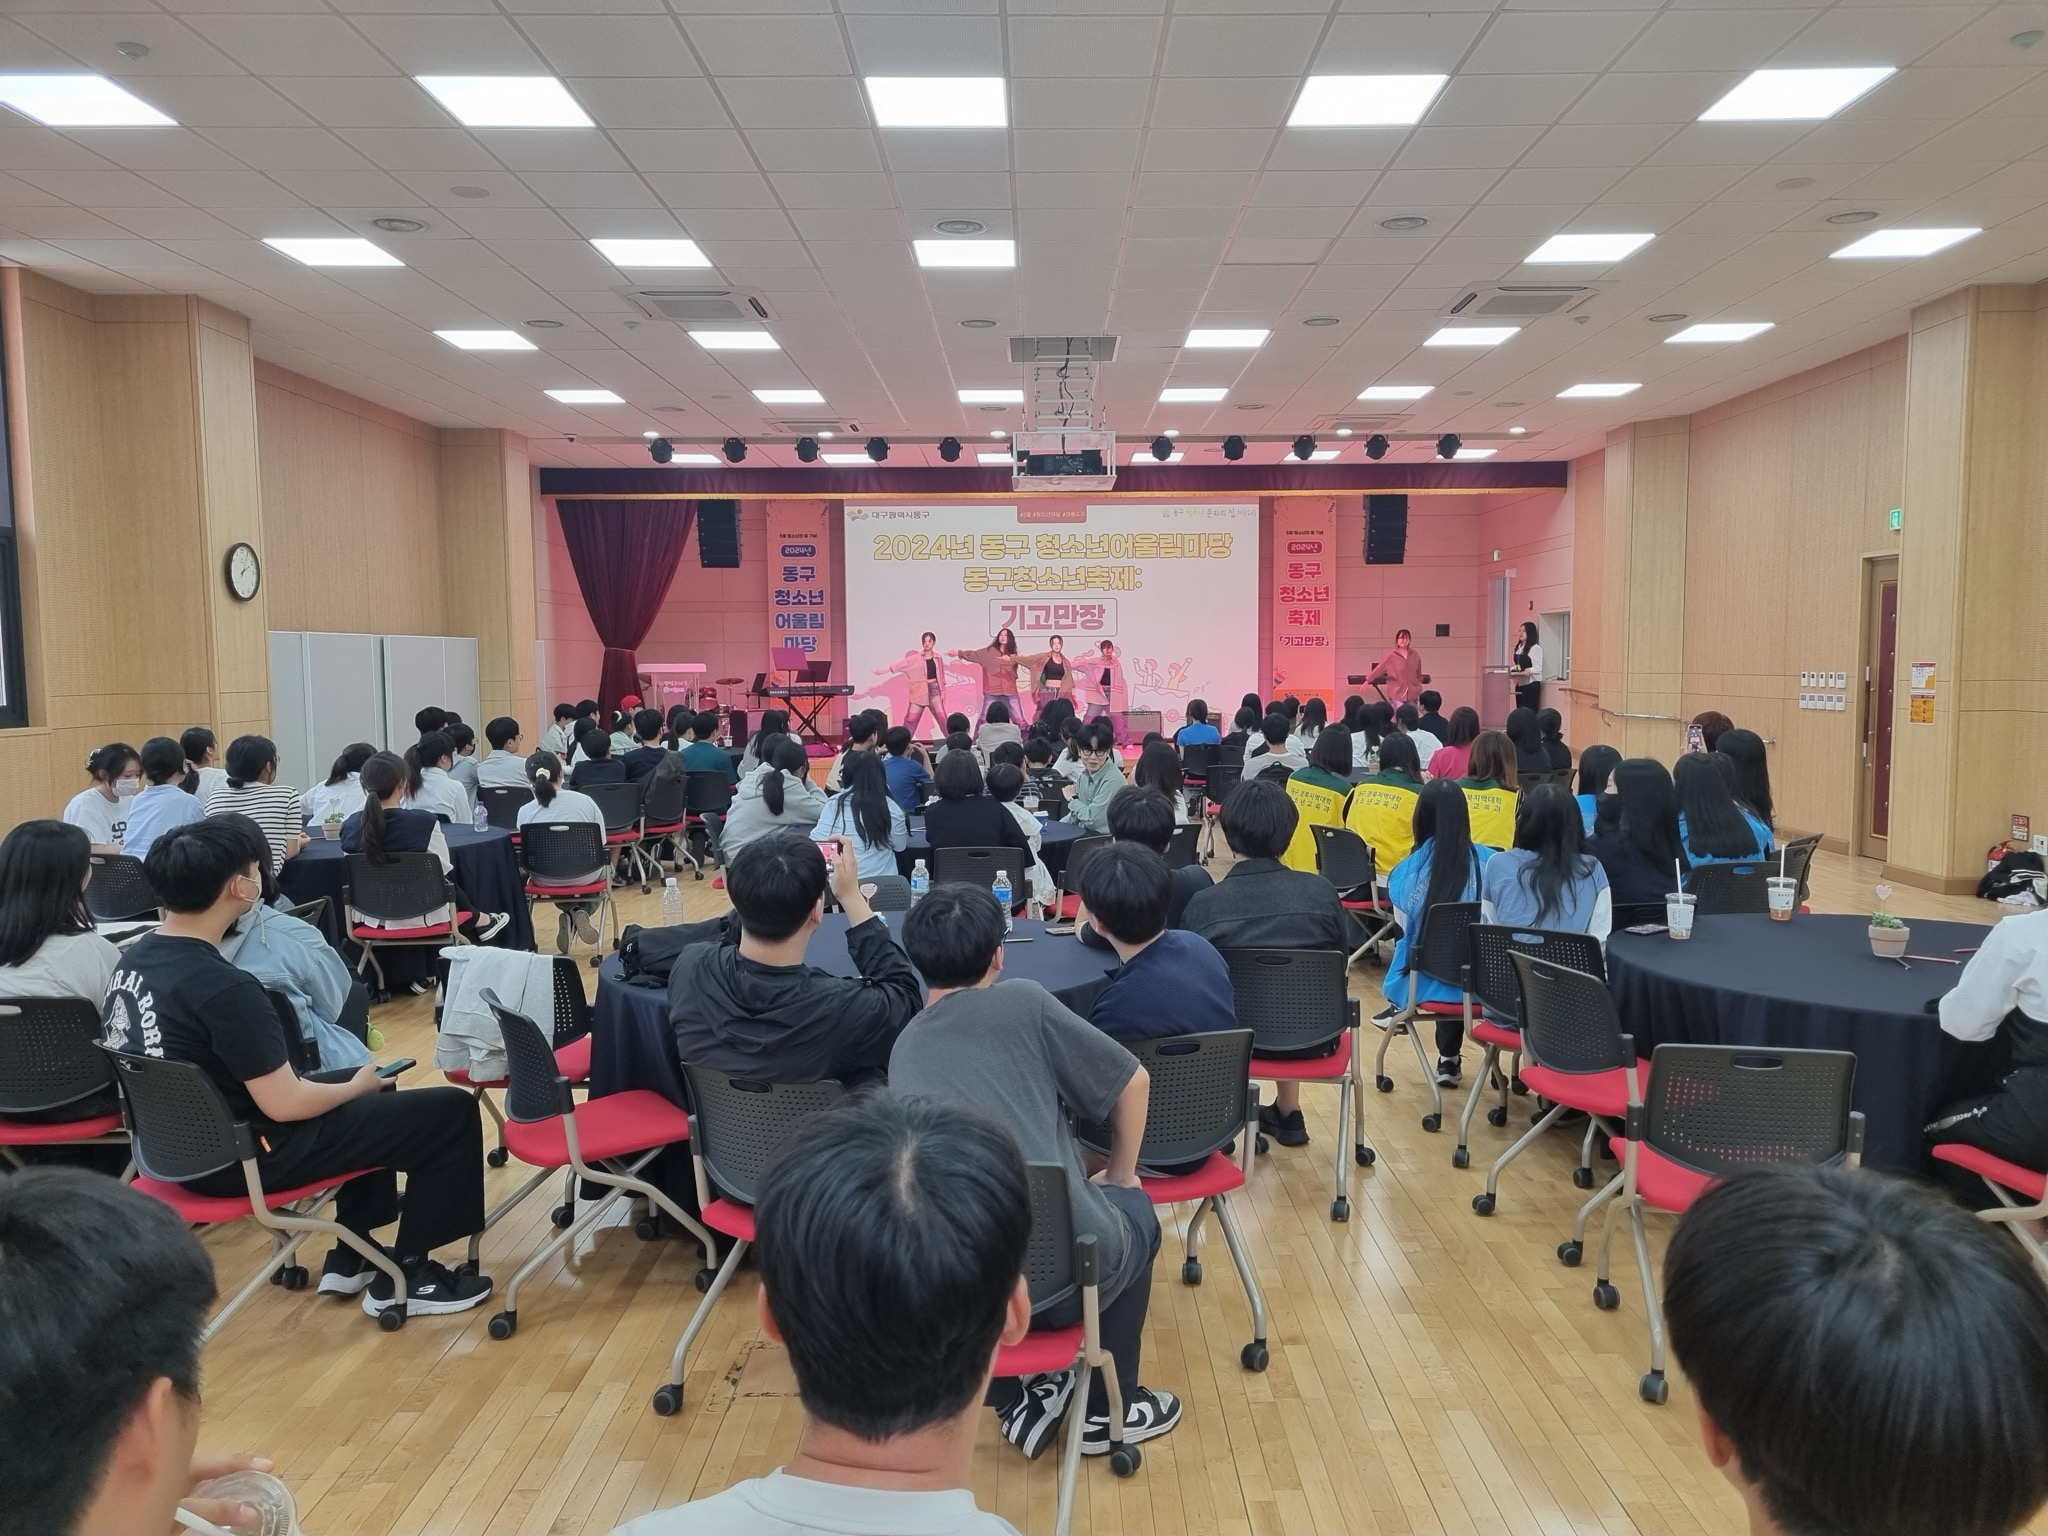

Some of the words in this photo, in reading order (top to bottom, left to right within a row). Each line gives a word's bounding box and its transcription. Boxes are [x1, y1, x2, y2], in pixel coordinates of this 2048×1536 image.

[872, 511, 930, 520] 대구광역시동구
[784, 546, 812, 557] 2024년
[873, 534, 975, 561] 2024년
[980, 534, 1031, 560] 동구
[1035, 532, 1234, 560] 청소년어울림마당
[1291, 543, 1318, 553] 2024년
[782, 565, 816, 583] 동구
[962, 565, 1143, 592] 동구청소년축제:
[1287, 562, 1322, 580] 동구
[774, 588, 825, 606] 청소년
[1279, 585, 1330, 603] 청소년
[775, 612, 825, 630] 어울림
[1000, 604, 1106, 631] 기고만장
[1287, 609, 1321, 626] 축제
[783, 636, 818, 653] 마당
